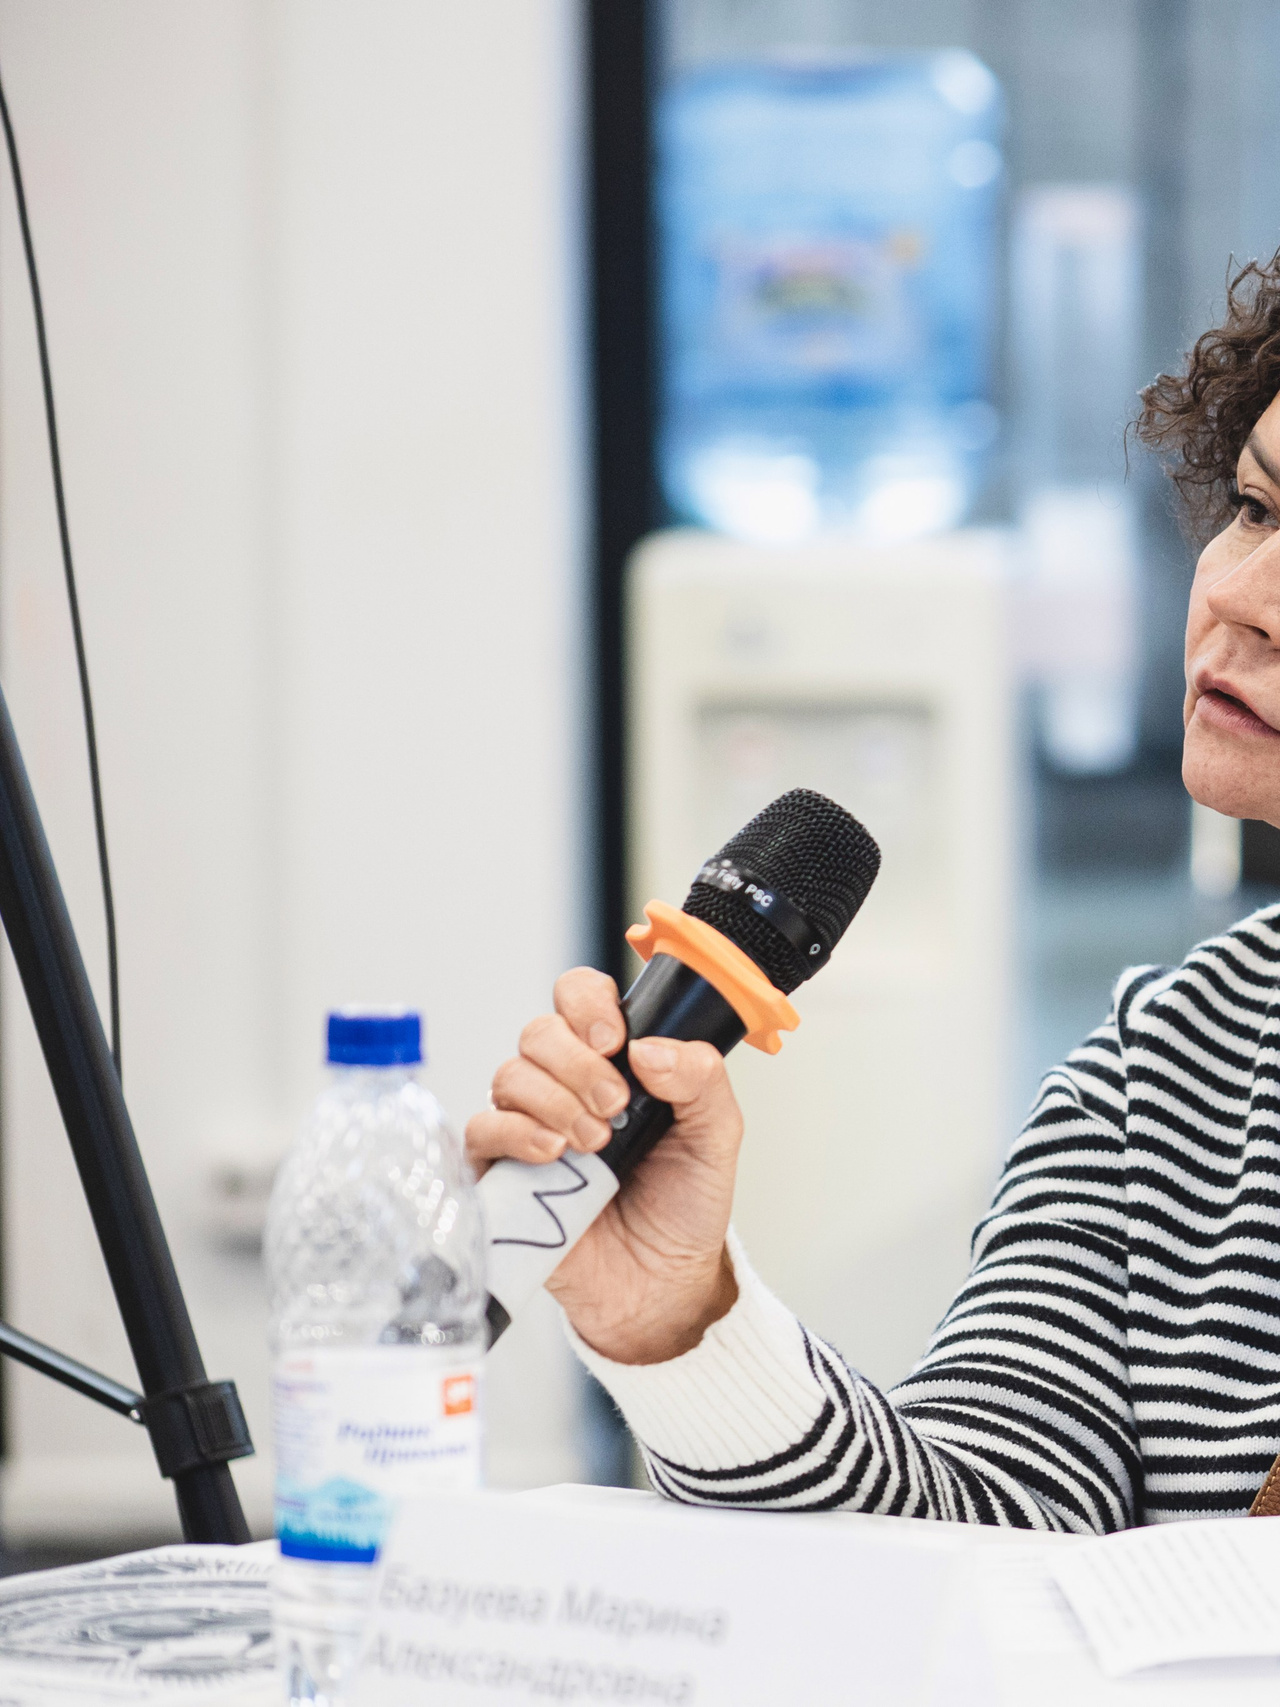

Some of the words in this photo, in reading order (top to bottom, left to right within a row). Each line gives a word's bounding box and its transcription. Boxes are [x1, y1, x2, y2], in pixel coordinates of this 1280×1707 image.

[744, 883, 773, 908] PSC
[379, 1564, 548, 1627] Базуева
[559, 1585, 729, 1645] Марина
[366, 1631, 695, 1705] Александровна
